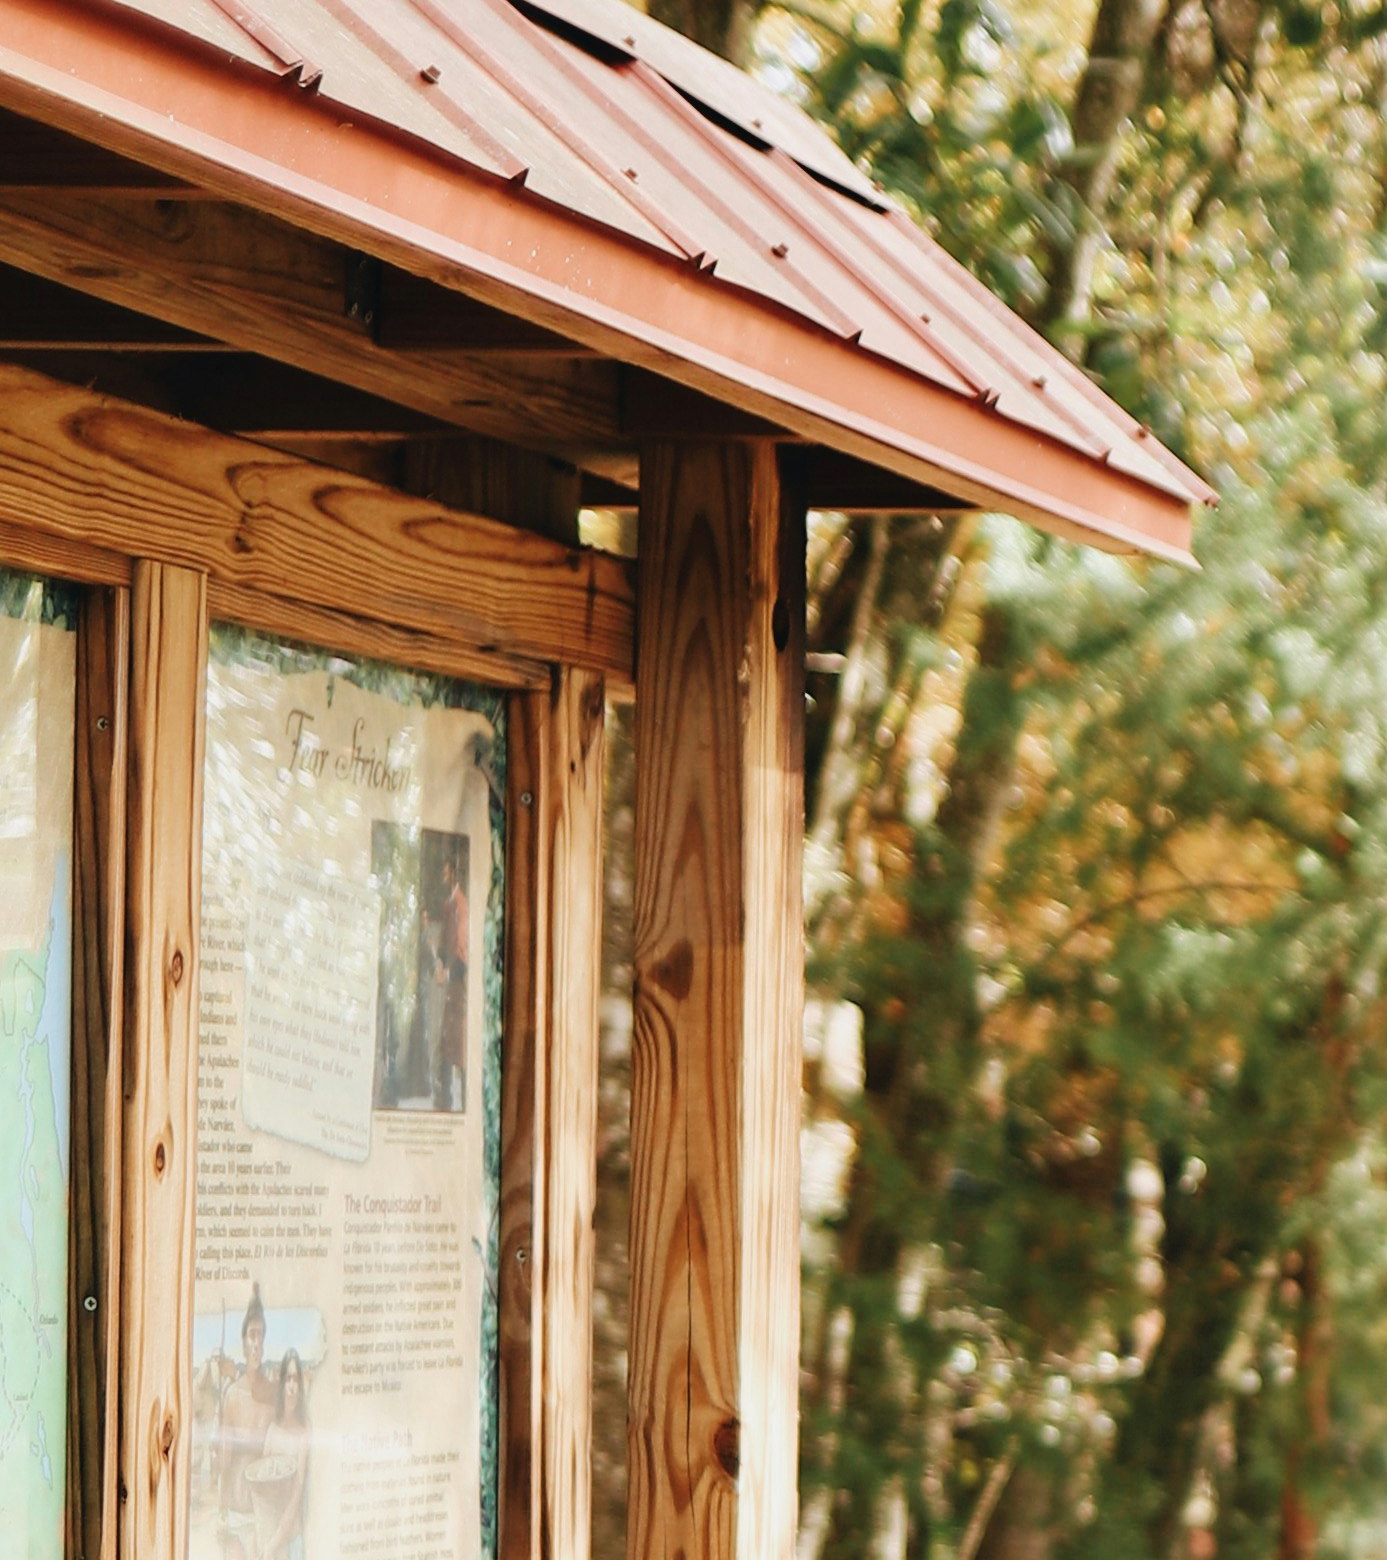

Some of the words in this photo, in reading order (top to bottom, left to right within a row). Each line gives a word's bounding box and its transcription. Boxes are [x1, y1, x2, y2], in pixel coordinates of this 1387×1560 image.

[285, 707, 330, 779] Fear
[335, 716, 412, 794] Stricken
[250, 1182, 260, 1195] the
[220, 1202, 232, 1216] and
[344, 1192, 361, 1214] The
[363, 1192, 421, 1219] Conquistador
[424, 1191, 442, 1214] Trail
[343, 1221, 382, 1239] Conquistador
[343, 1260, 363, 1273] known
[408, 1258, 419, 1272] and
[444, 1297, 456, 1311] and
[341, 1382, 353, 1395] and
[360, 1429, 390, 1451] Native
[391, 1425, 414, 1449] Path
